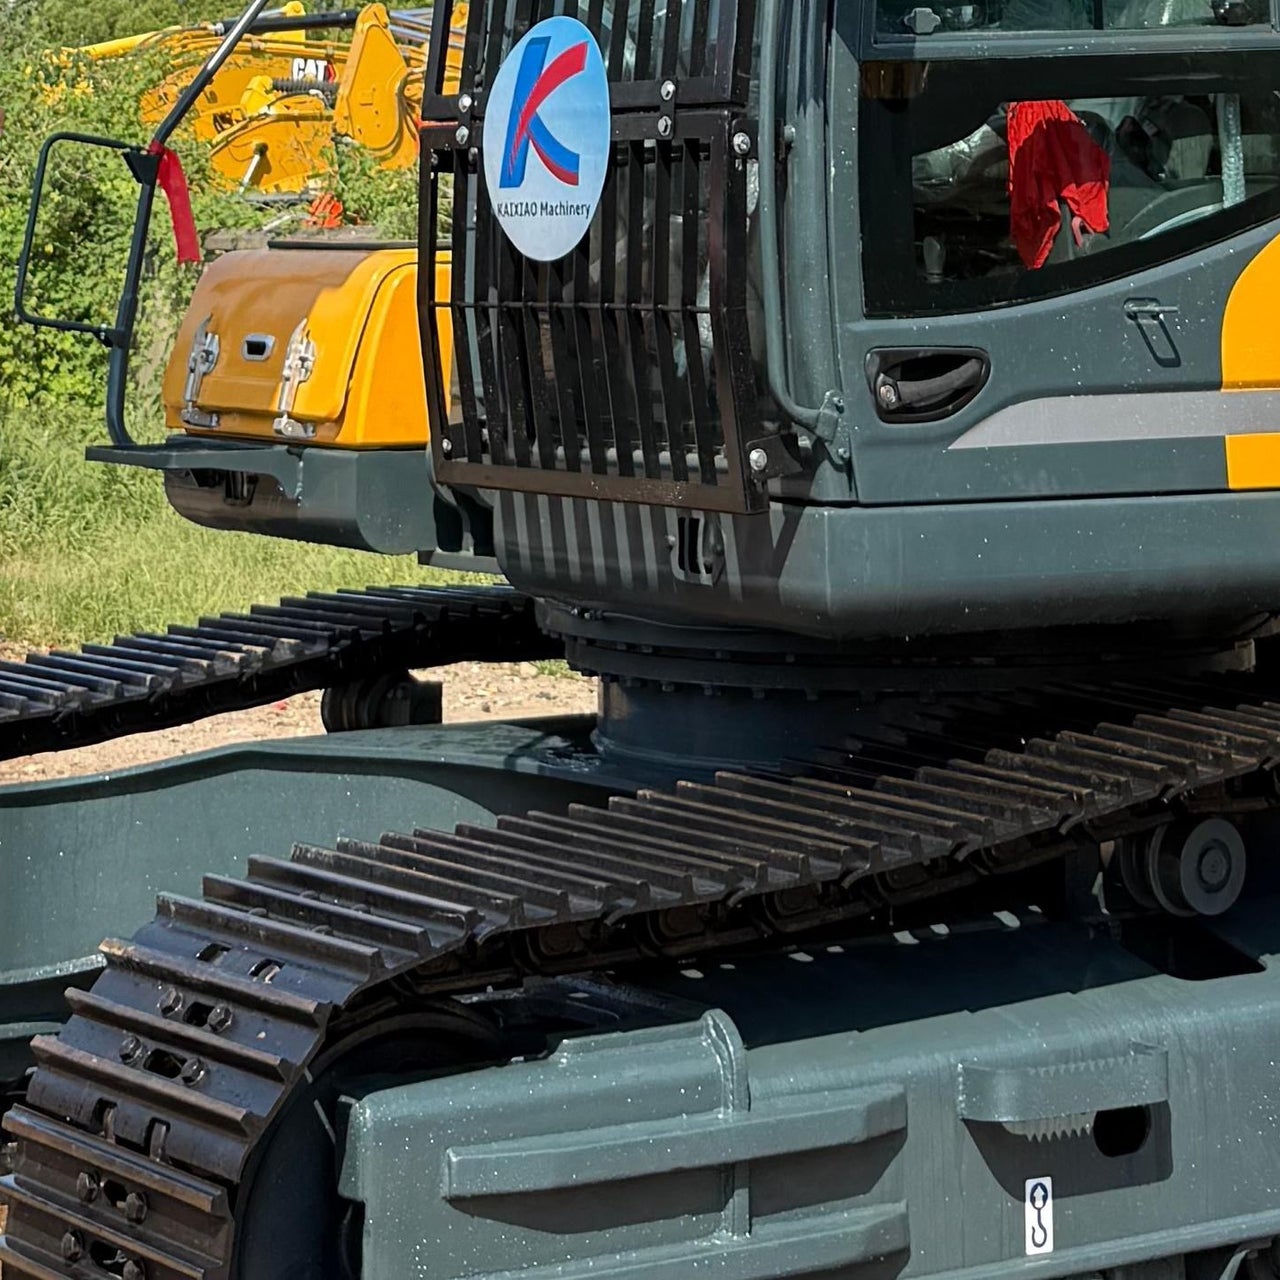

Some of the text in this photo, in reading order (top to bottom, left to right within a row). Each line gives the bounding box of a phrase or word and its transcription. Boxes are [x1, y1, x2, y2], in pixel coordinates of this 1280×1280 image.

[292, 57, 328, 83] CAT
[497, 200, 591, 219] KAIXIAO Machinery
